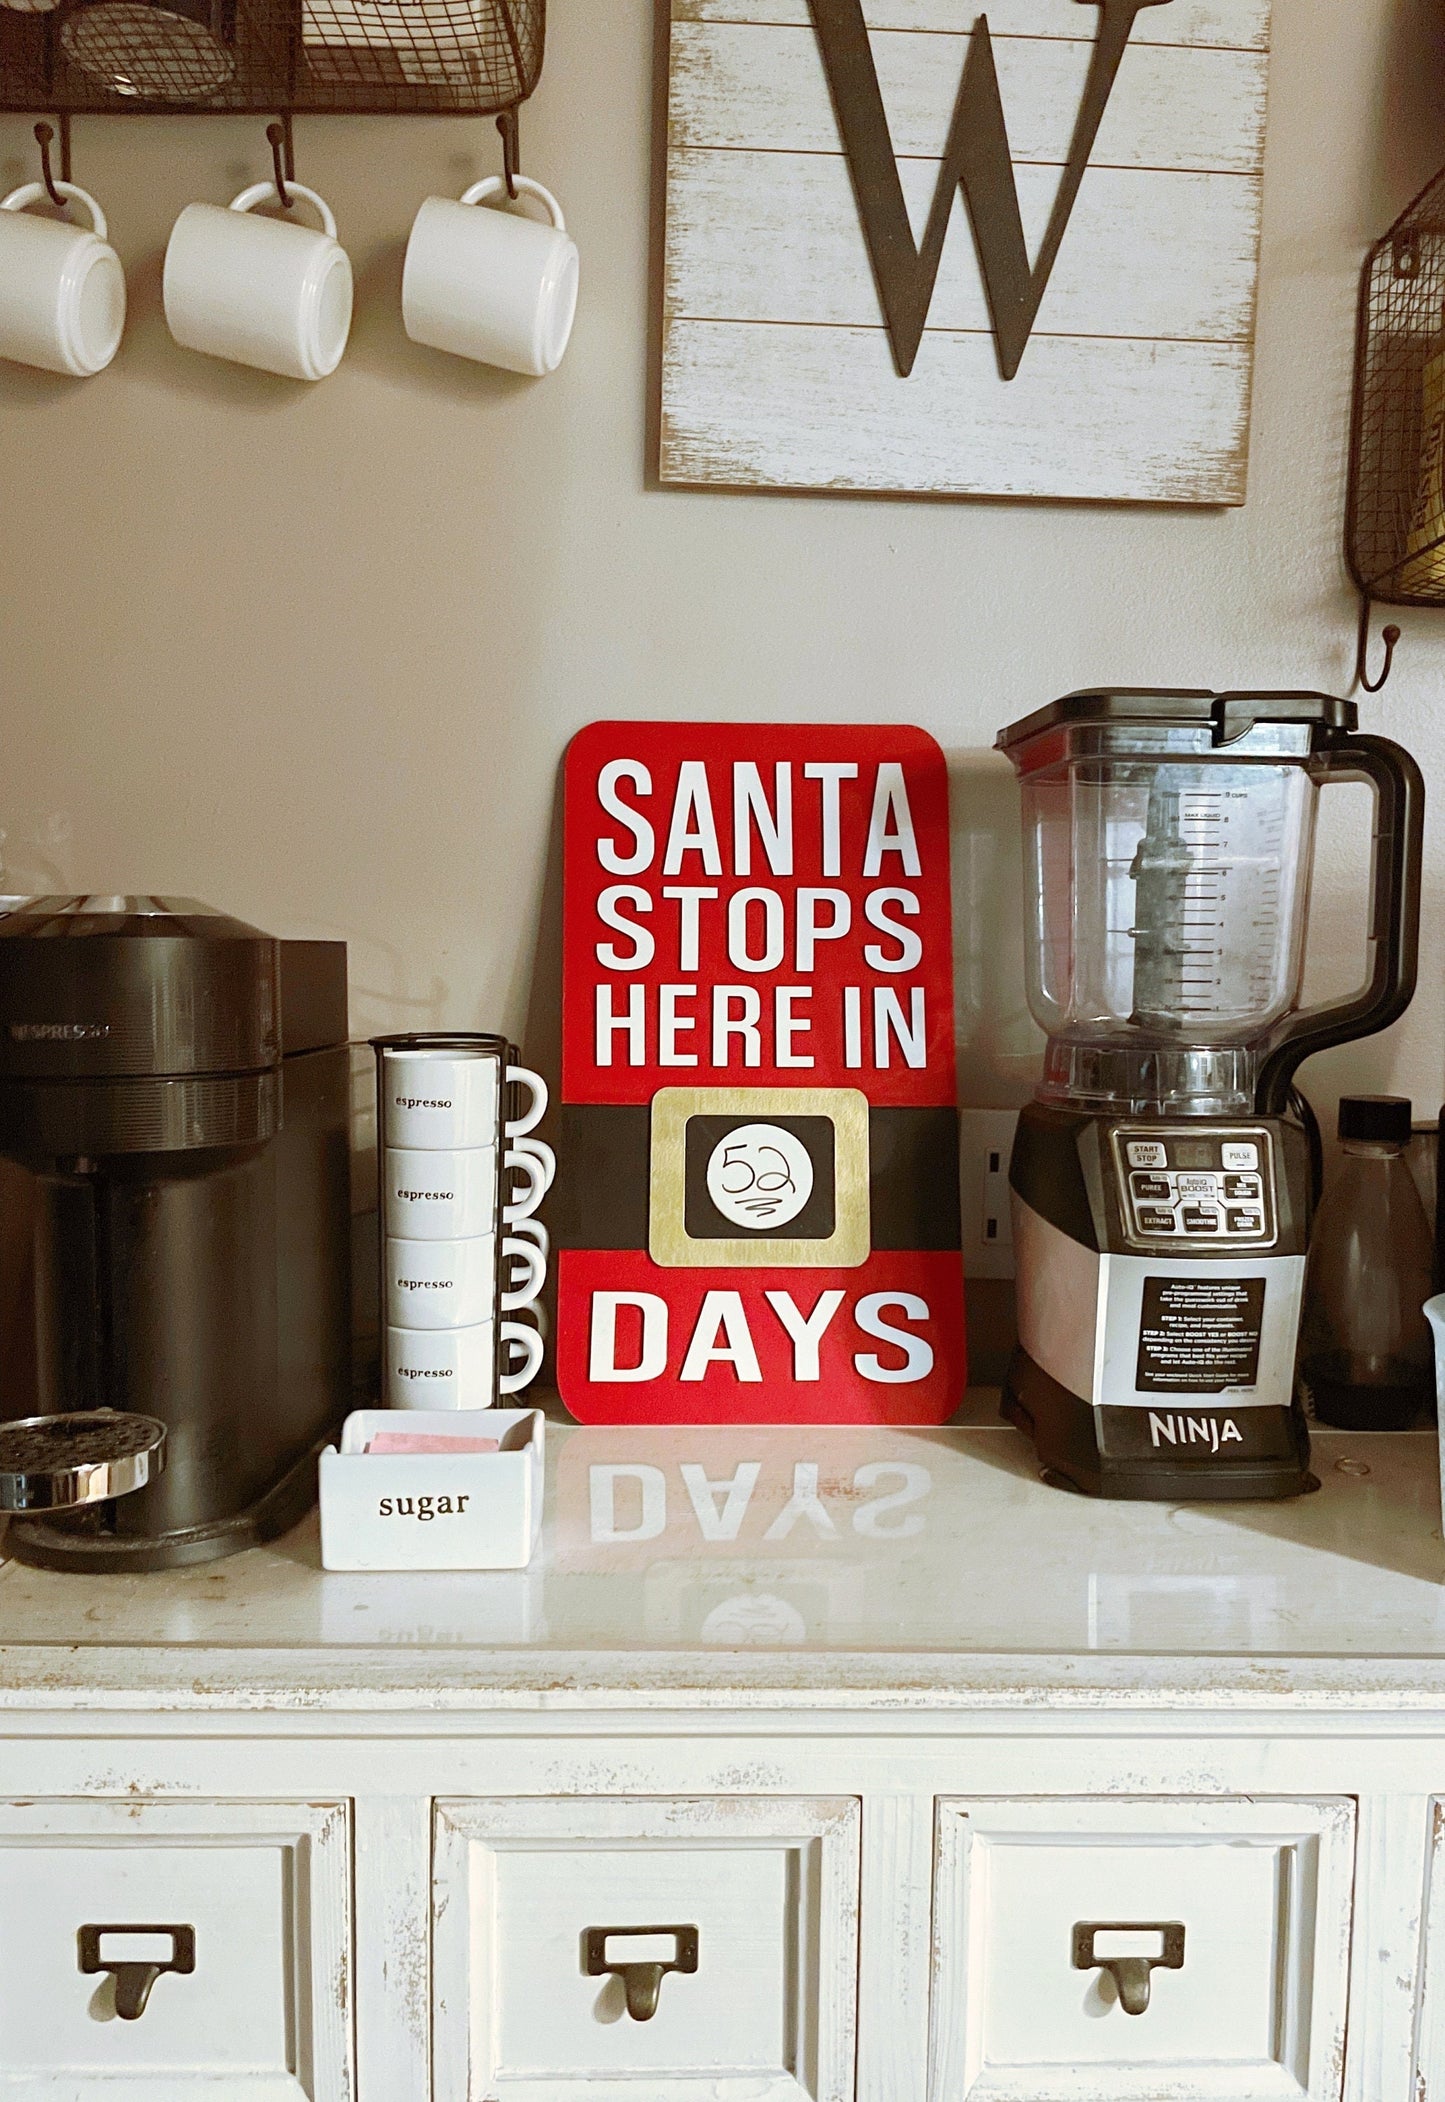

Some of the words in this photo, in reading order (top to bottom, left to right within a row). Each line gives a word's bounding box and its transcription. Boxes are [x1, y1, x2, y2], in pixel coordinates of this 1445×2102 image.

[809, 0, 1174, 381] W
[597, 758, 922, 877] SANTA
[596, 884, 923, 973] STOPS
[596, 984, 815, 1068] HERE
[844, 986, 927, 1069] IN
[395, 1096, 452, 1109] espresso
[721, 1144, 796, 1195] 52
[397, 1188, 454, 1201] espresso
[1144, 1217, 1172, 1225] EXTRACT
[397, 1278, 453, 1290] espresso
[589, 1290, 933, 1384] DAYS
[398, 1367, 453, 1379] espresso
[1149, 1411, 1243, 1453] NINJA
[379, 1495, 470, 1521] sugar
